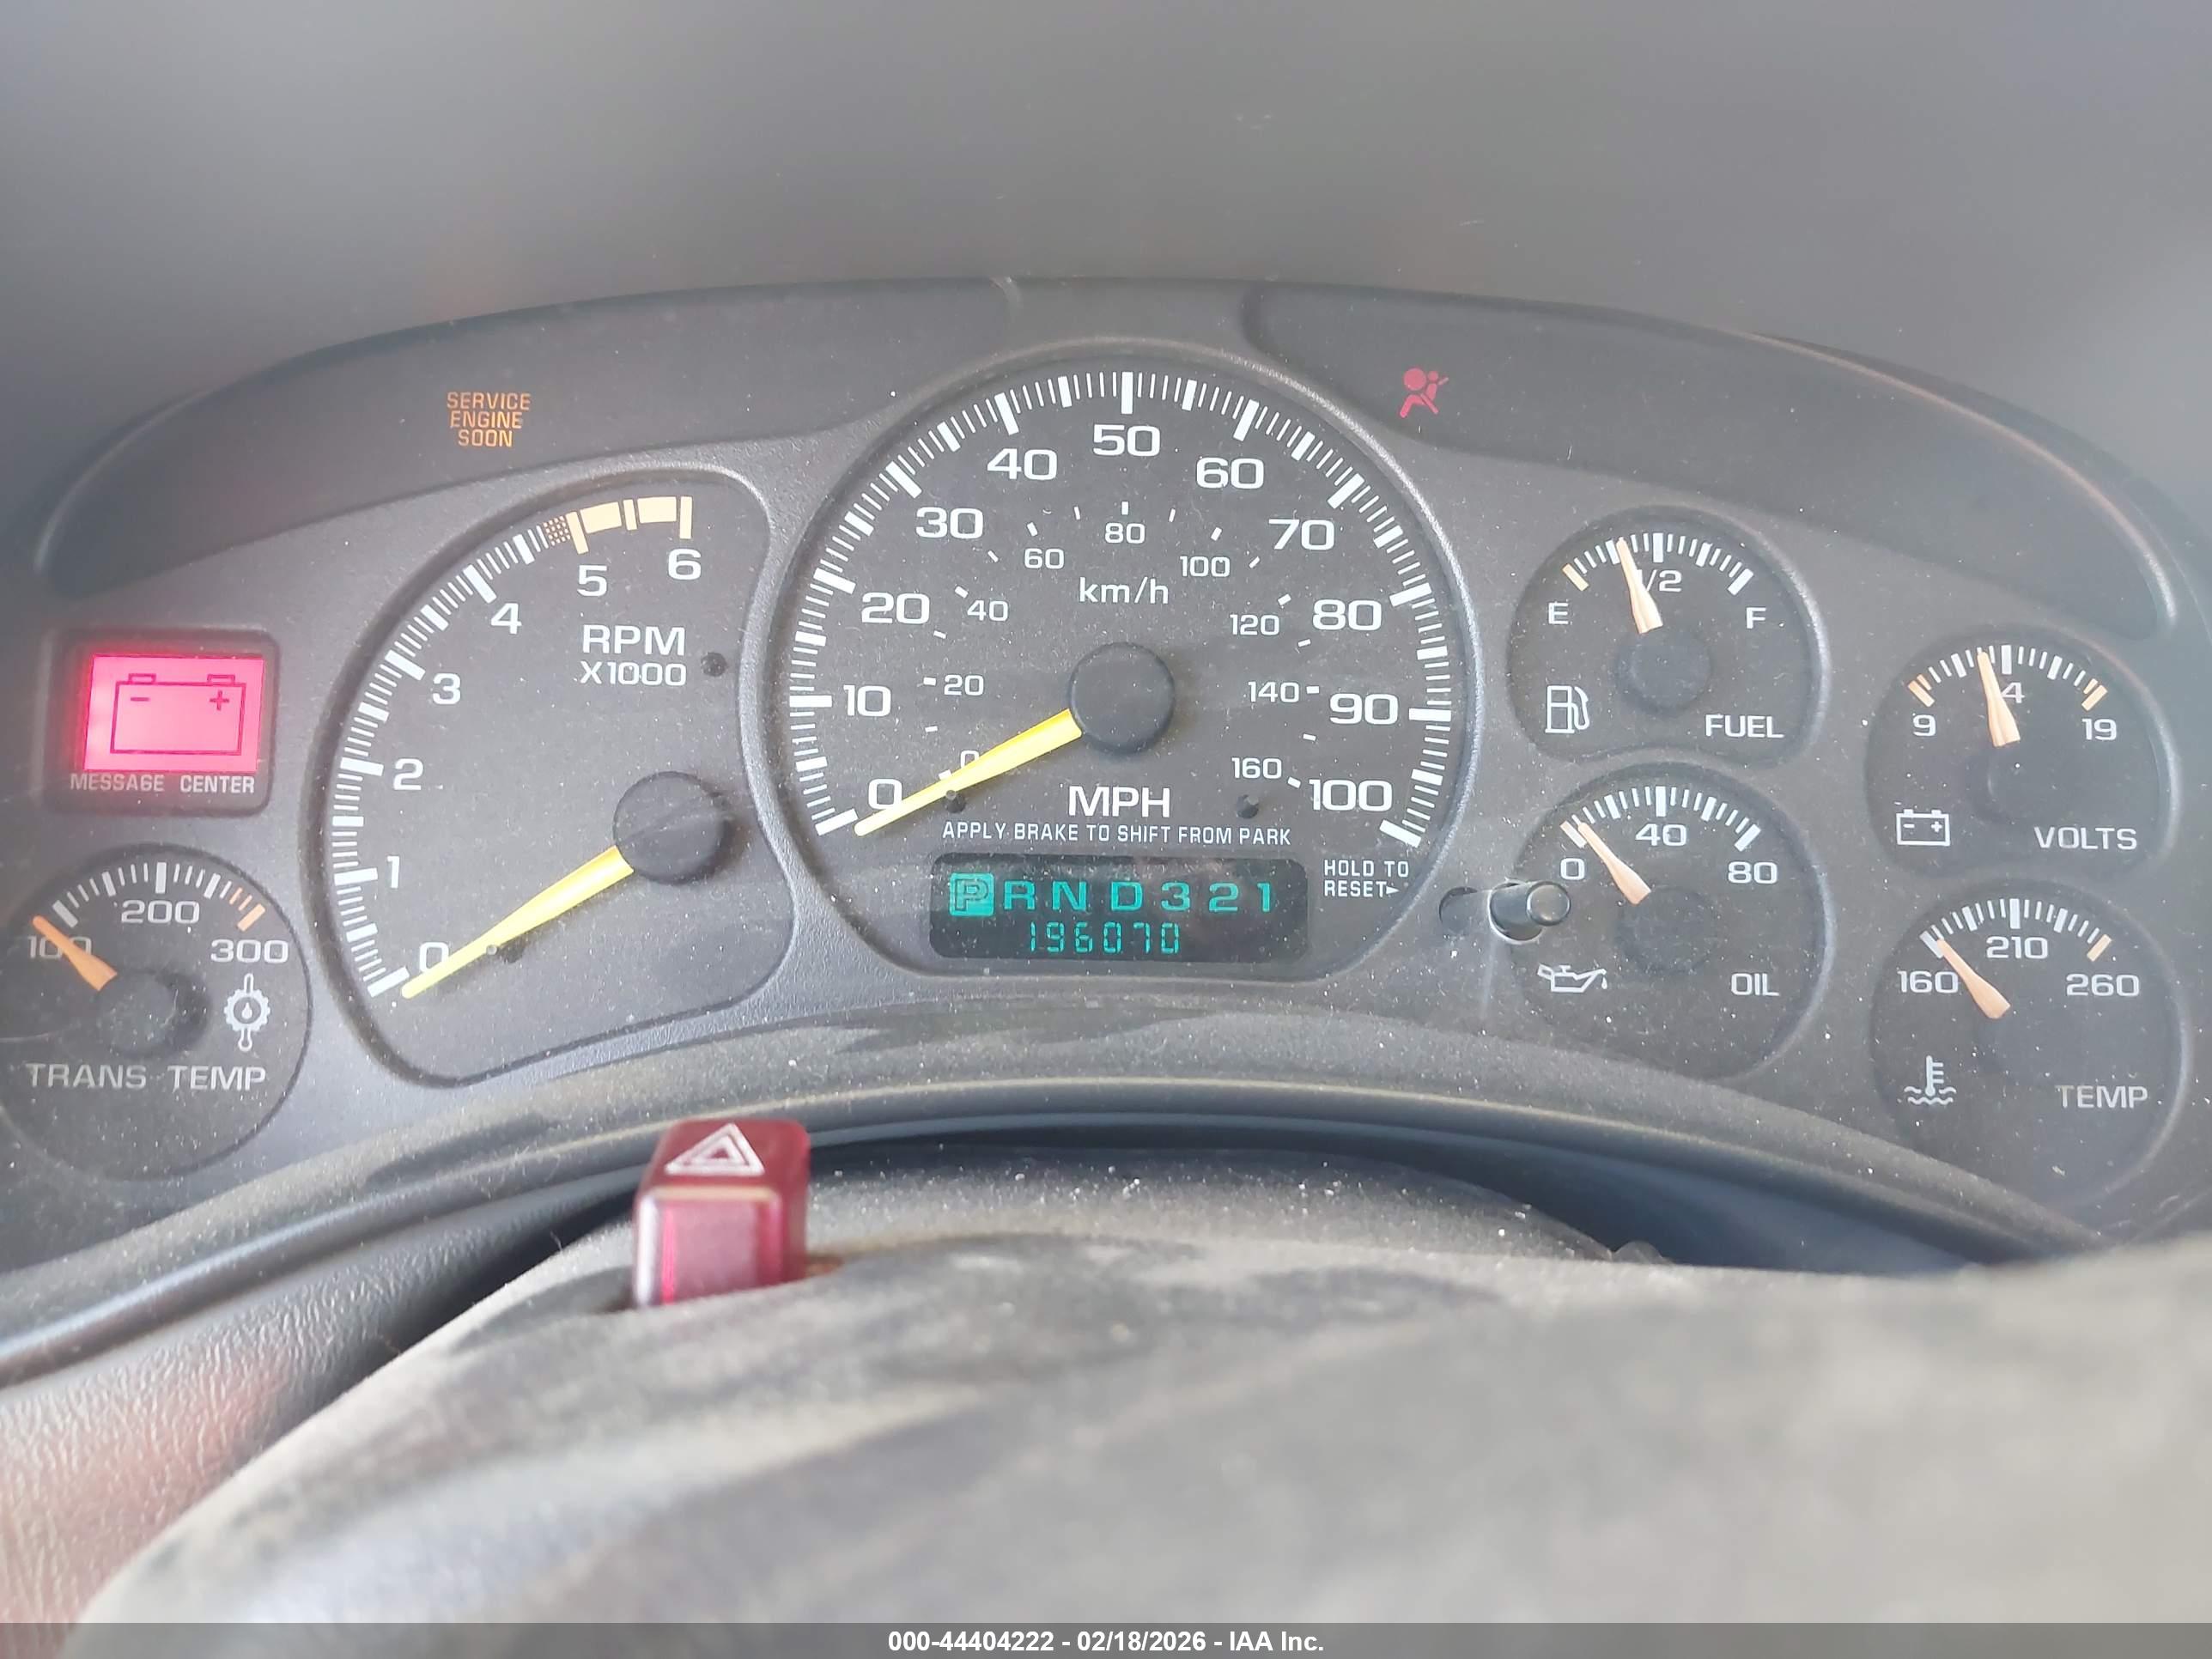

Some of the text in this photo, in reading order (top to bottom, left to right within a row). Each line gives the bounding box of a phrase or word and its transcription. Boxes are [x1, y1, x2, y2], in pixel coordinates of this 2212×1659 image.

[447, 392, 530, 410] SERVICE
[450, 410, 522, 428] ENGINE
[458, 429, 513, 447] SOON
[1094, 425, 1159, 456] 50
[988, 449, 1057, 480] 40
[1197, 457, 1263, 489] 60
[916, 507, 983, 538] 30
[1105, 523, 1145, 544] 80
[1269, 520, 1334, 550] 70
[669, 549, 701, 580] 6
[1025, 549, 1064, 568] 60
[1180, 556, 1230, 577] 100
[578, 565, 606, 596] 5
[1080, 577, 1168, 604] km/h
[490, 603, 521, 634] 4
[862, 592, 929, 623] 20
[968, 600, 1008, 621] 40
[1313, 599, 1381, 630] 80
[1549, 602, 1568, 624] E
[1747, 608, 1765, 629] F
[1231, 615, 1279, 635] 120
[583, 625, 684, 655] RPM
[580, 661, 686, 685] X1000
[433, 673, 460, 704] 3
[945, 675, 983, 696] 20
[1249, 682, 1298, 702] 140
[843, 685, 890, 716] 10
[1330, 694, 1398, 724] 90
[1706, 714, 1784, 738] FUEL
[1913, 715, 1936, 736] 9
[2082, 719, 2117, 740] 19
[393, 759, 422, 790] 2
[1232, 758, 1281, 778] 160
[70, 774, 255, 793] MESSAGE CENTER
[868, 778, 902, 811] 0
[1069, 787, 1170, 817] MPH
[1310, 780, 1392, 811] 100
[943, 822, 1290, 845] APPLY BRAKE TO SHIFT FROM PARK
[1636, 823, 1686, 846] 40
[2035, 827, 2136, 849] VOLTS
[387, 856, 399, 888] 1
[1325, 860, 1408, 877] HOLD TO
[1561, 859, 1584, 879] 0
[1729, 862, 1777, 884] 80
[1325, 880, 1386, 897] RESET
[122, 901, 199, 923] 200
[1031, 922, 1179, 953] 196070
[1987, 937, 2047, 958] 210
[211, 939, 288, 963] 300
[419, 941, 450, 974] 0
[1731, 974, 1779, 995] OIL
[1898, 970, 1958, 993] 160
[2067, 974, 2139, 996] 260
[26, 1064, 265, 1091] TRANS TEMP
[2057, 1086, 2148, 1108] TEMP
